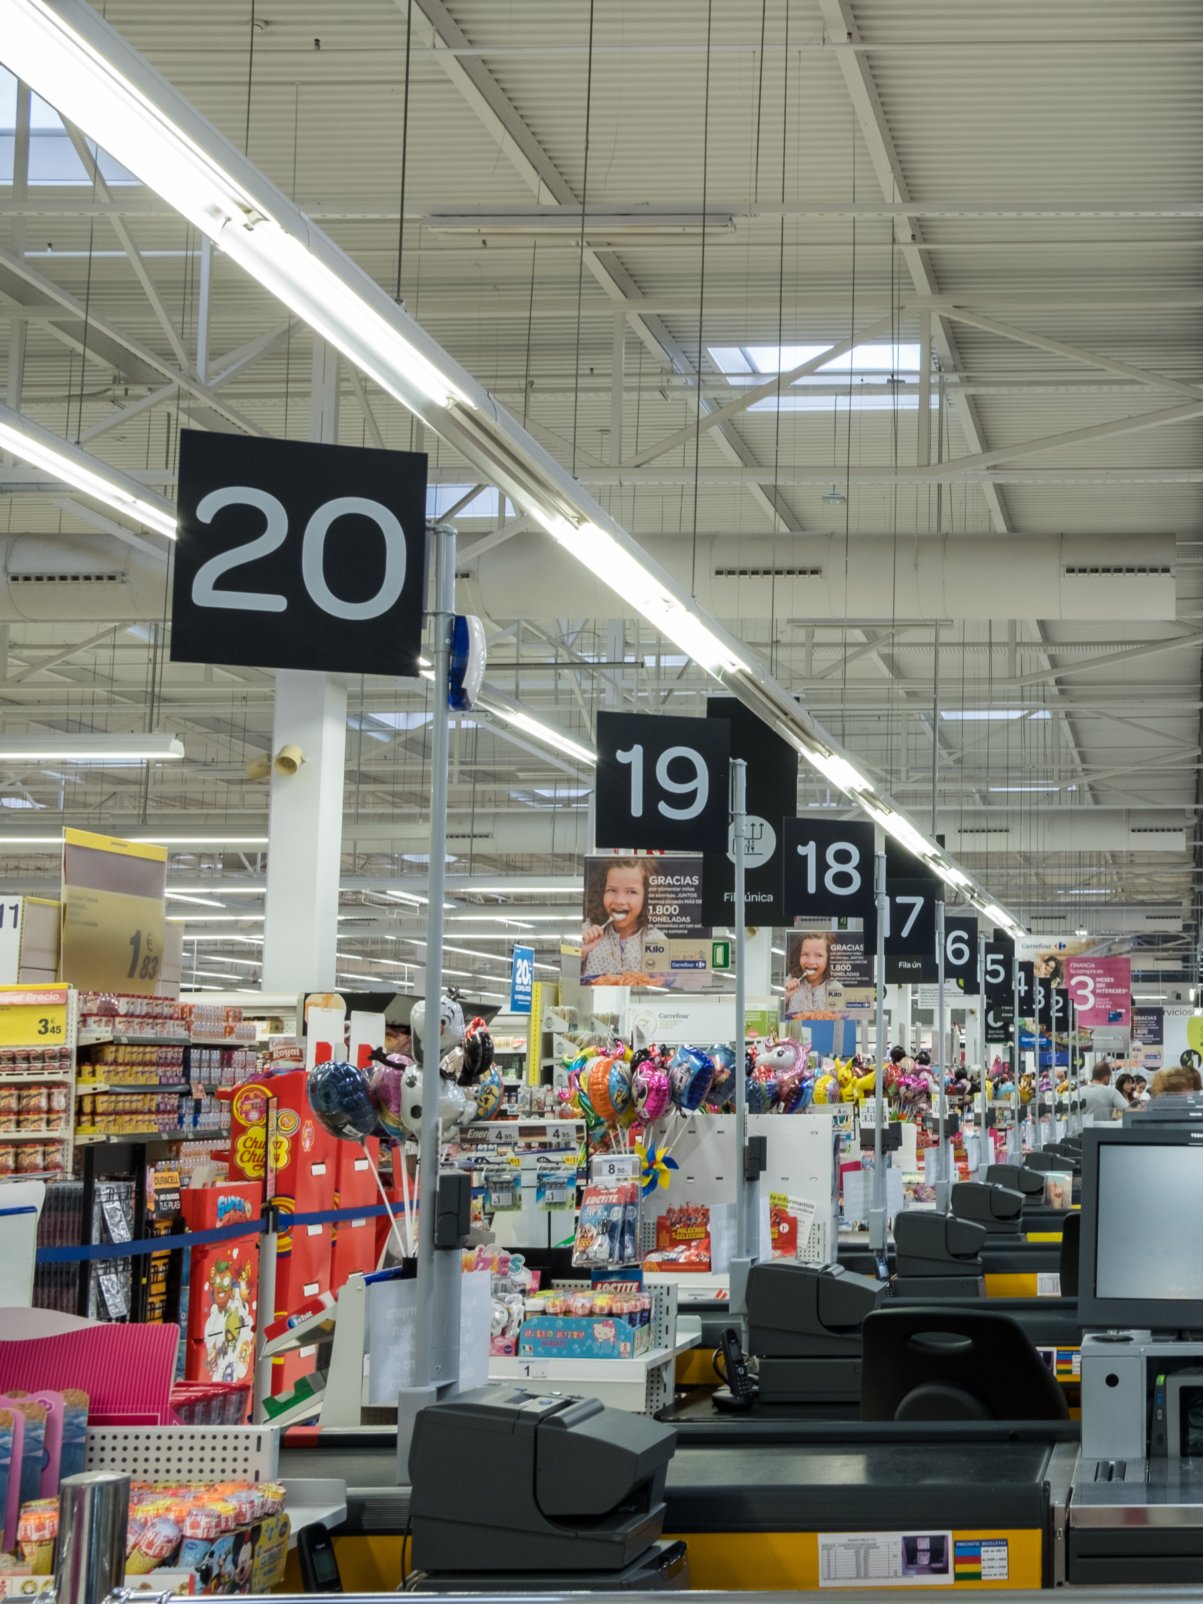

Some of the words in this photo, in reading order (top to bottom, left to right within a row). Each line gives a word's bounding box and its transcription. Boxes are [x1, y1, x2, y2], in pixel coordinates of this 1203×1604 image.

[192, 486, 407, 620] 20
[615, 744, 709, 820] 19
[797, 841, 861, 895] 18
[649, 876, 699, 885] GRACIAS
[648, 905, 679, 915] 1.800
[645, 945, 665, 953] Kilo
[127, 930, 142, 978] 1
[139, 955, 159, 980] 83
[899, 959, 911, 969] Fila
[1070, 975, 1095, 1011] 3
[1163, 1009, 1193, 1017] rvicios
[37, 1018, 49, 1035] 3
[50, 1026, 61, 1034] 45
[273, 1048, 300, 1059] Royal
[495, 1131, 503, 1140] 4
[553, 1129, 560, 1139] 4
[608, 1164, 615, 1174] 8
[155, 1176, 178, 1185] DURACELL
[585, 1195, 618, 1203] LOCTITE
[778, 1197, 815, 1209] informamos
[596, 1282, 638, 1293] LOCTITE
[524, 1329, 554, 1338] HELLO
[557, 1330, 584, 1338] KITTY
[524, 1366, 530, 1377] 1
